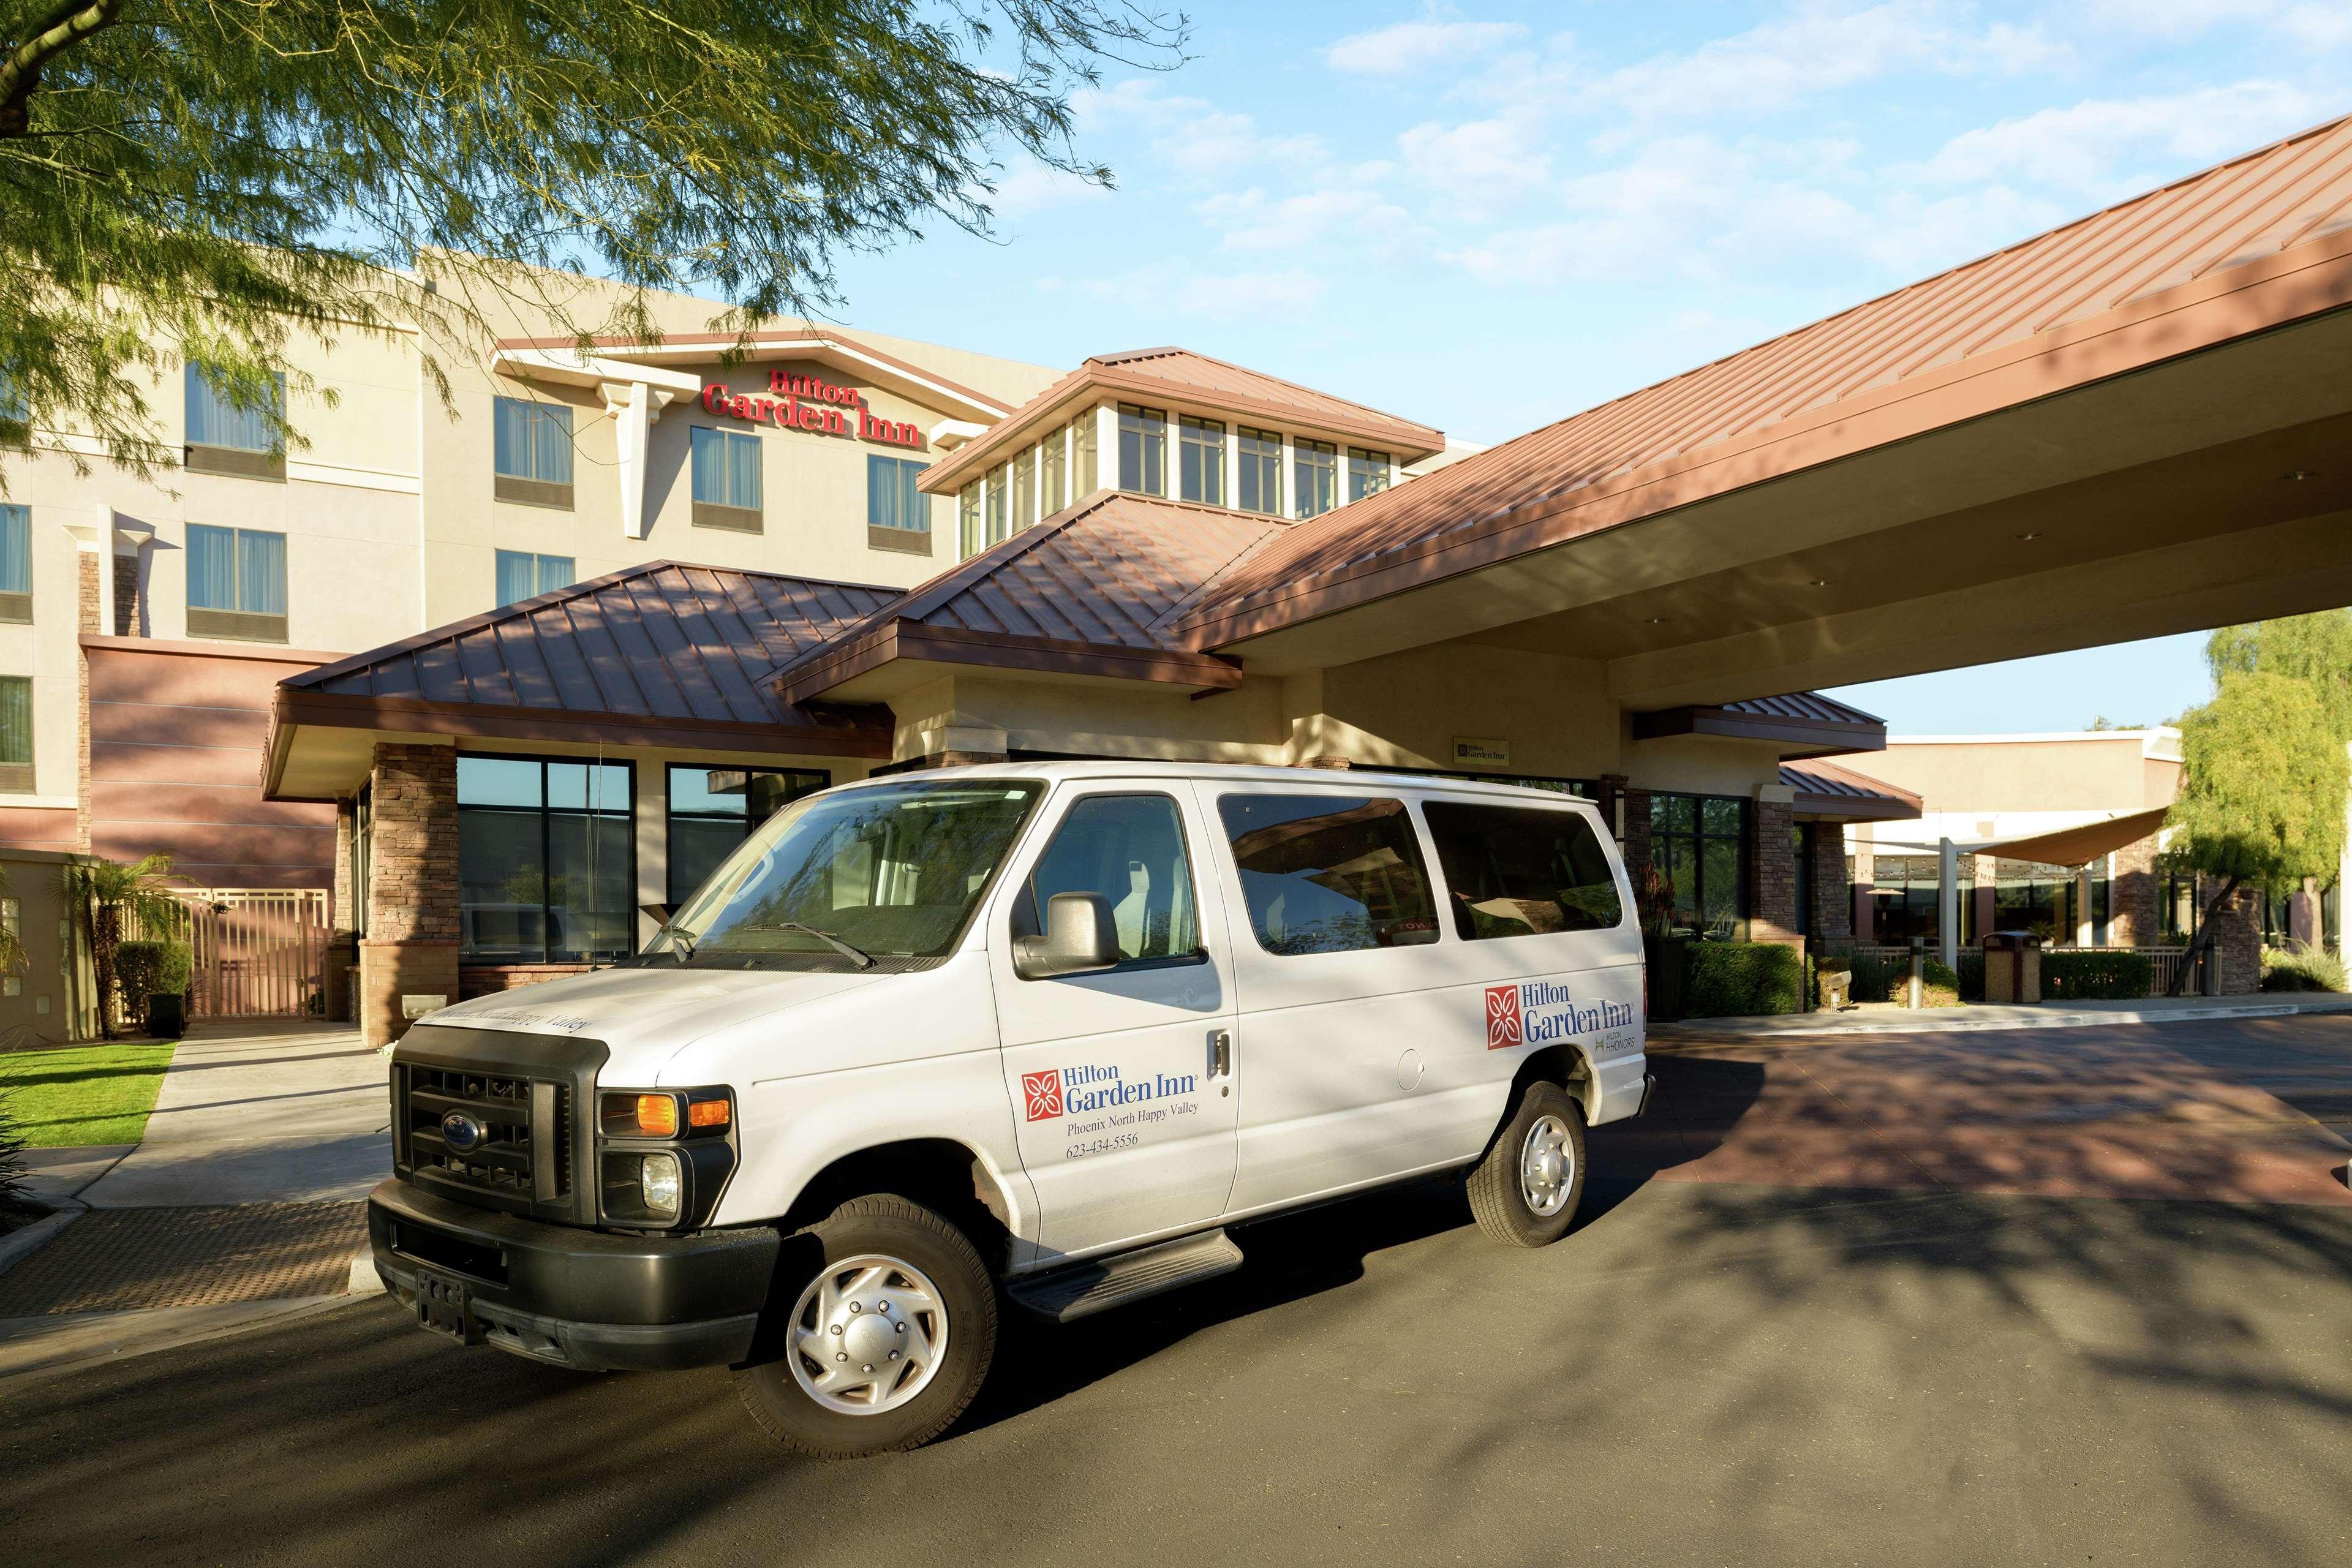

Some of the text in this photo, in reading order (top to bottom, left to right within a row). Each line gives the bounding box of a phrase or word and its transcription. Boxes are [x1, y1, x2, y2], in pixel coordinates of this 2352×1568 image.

[768, 369, 861, 407] Hilton
[702, 383, 922, 447] Garden Inn
[1468, 750, 1492, 759] Garden
[1521, 982, 1570, 1008] Hilton
[545, 1014, 593, 1033] Valley
[1525, 1003, 1599, 1042] Garden
[1607, 1031, 1621, 1041] HILTON
[1606, 1036, 1635, 1053] HHONORS
[1063, 1064, 1120, 1087] Hilton
[1066, 1080, 1153, 1114] Garden
[1068, 1101, 1199, 1136] Phoenix North Happy Valley
[1066, 1132, 1138, 1159] 623-434-5556
[892, 1309, 972, 1431] SAVERO HT2
